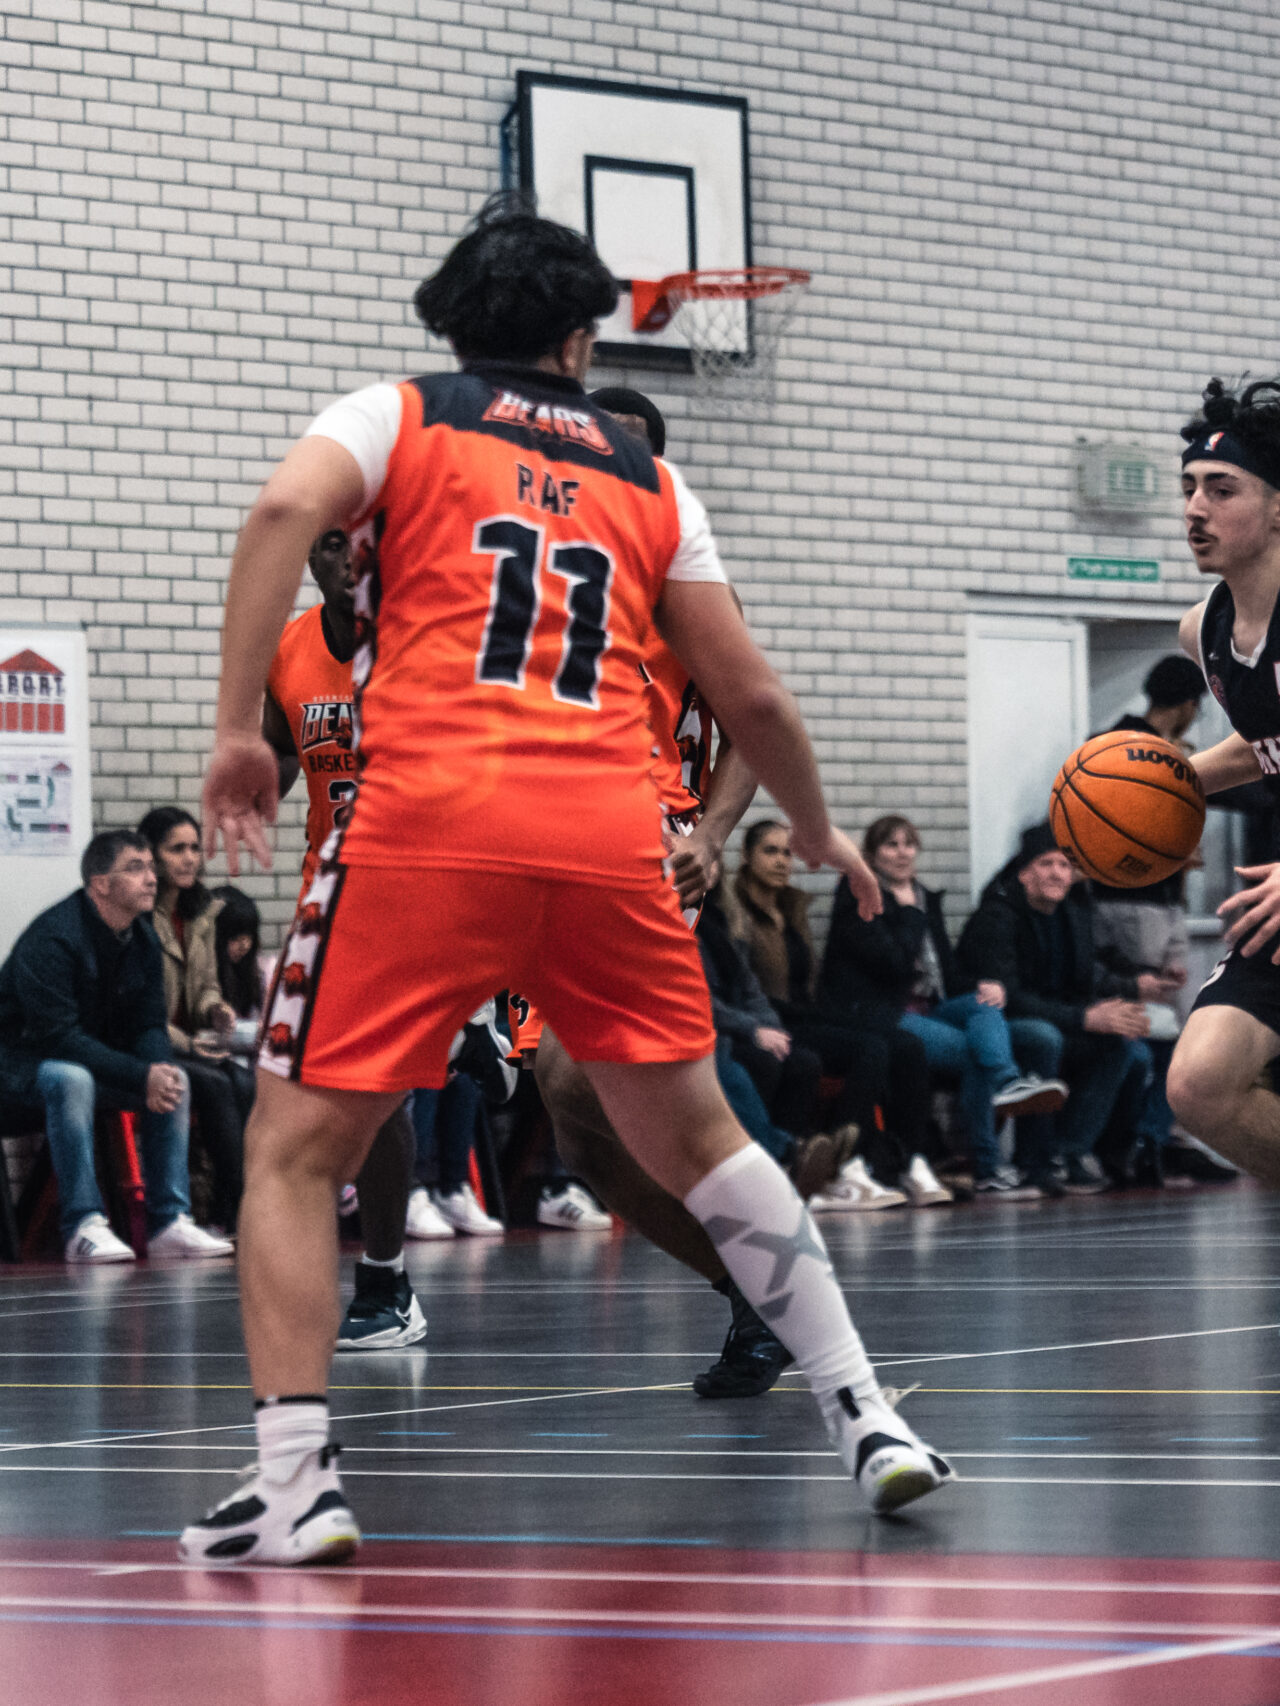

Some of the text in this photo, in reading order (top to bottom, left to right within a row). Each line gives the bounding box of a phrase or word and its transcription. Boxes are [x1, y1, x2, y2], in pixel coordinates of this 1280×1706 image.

[487, 390, 612, 454] BEARS
[516, 462, 580, 516] RAF
[472, 514, 616, 711] 11
